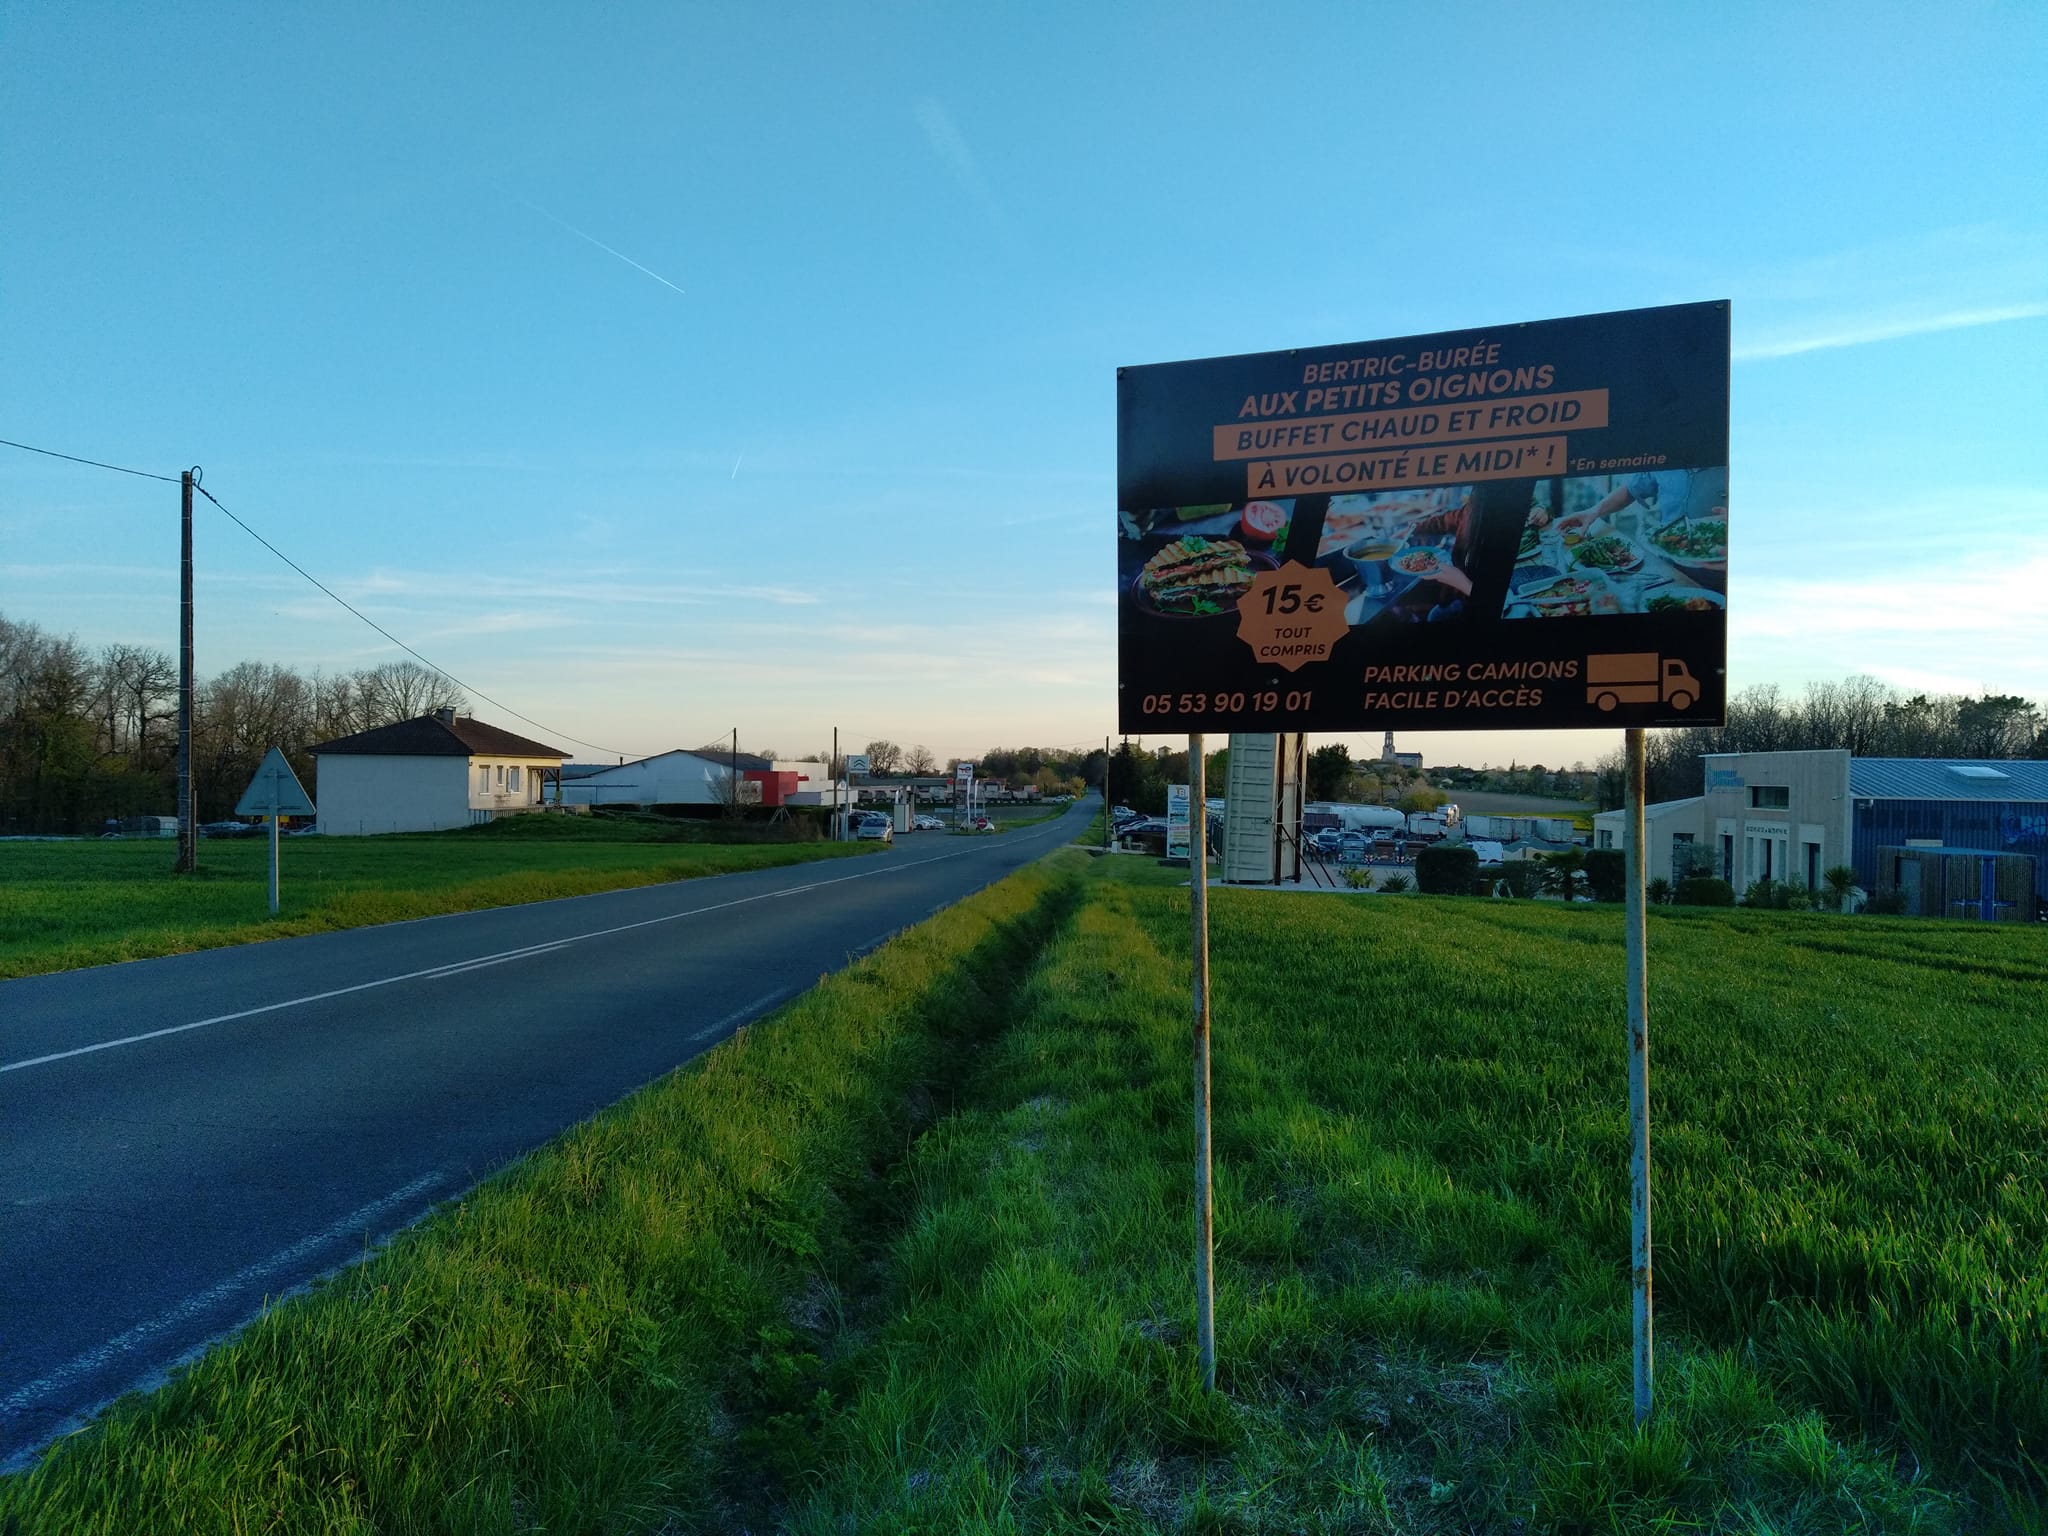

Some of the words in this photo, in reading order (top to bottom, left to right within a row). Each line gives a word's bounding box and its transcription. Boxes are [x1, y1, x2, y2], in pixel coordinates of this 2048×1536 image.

[1303, 339, 1501, 384] BERTRIC-BURÉE
[1238, 391, 1298, 418] AUX
[1304, 380, 1401, 412] PETITS
[1408, 364, 1555, 401] OIGNONS
[1237, 423, 1334, 452] BUFFET
[1341, 413, 1440, 442] CHAUD
[1448, 409, 1483, 432] ET
[1488, 399, 1583, 429] FROID
[1257, 467, 1277, 490] À
[1284, 450, 1410, 486] VOLONTÉ
[1416, 453, 1447, 478] LE
[1545, 444, 1556, 467] !
[1599, 452, 1667, 469] semaine
[1274, 626, 1313, 640] TOUT
[1260, 643, 1326, 657] COMPRIS
[1364, 663, 1460, 683] PARKING
[1466, 660, 1579, 682] CAMIONS
[1142, 694, 1172, 714] 05
[1178, 693, 1206, 714] 53
[1213, 692, 1245, 712] 90
[1251, 691, 1278, 712] 19
[1285, 691, 1313, 711] 01
[1364, 691, 1439, 710] FACILE
